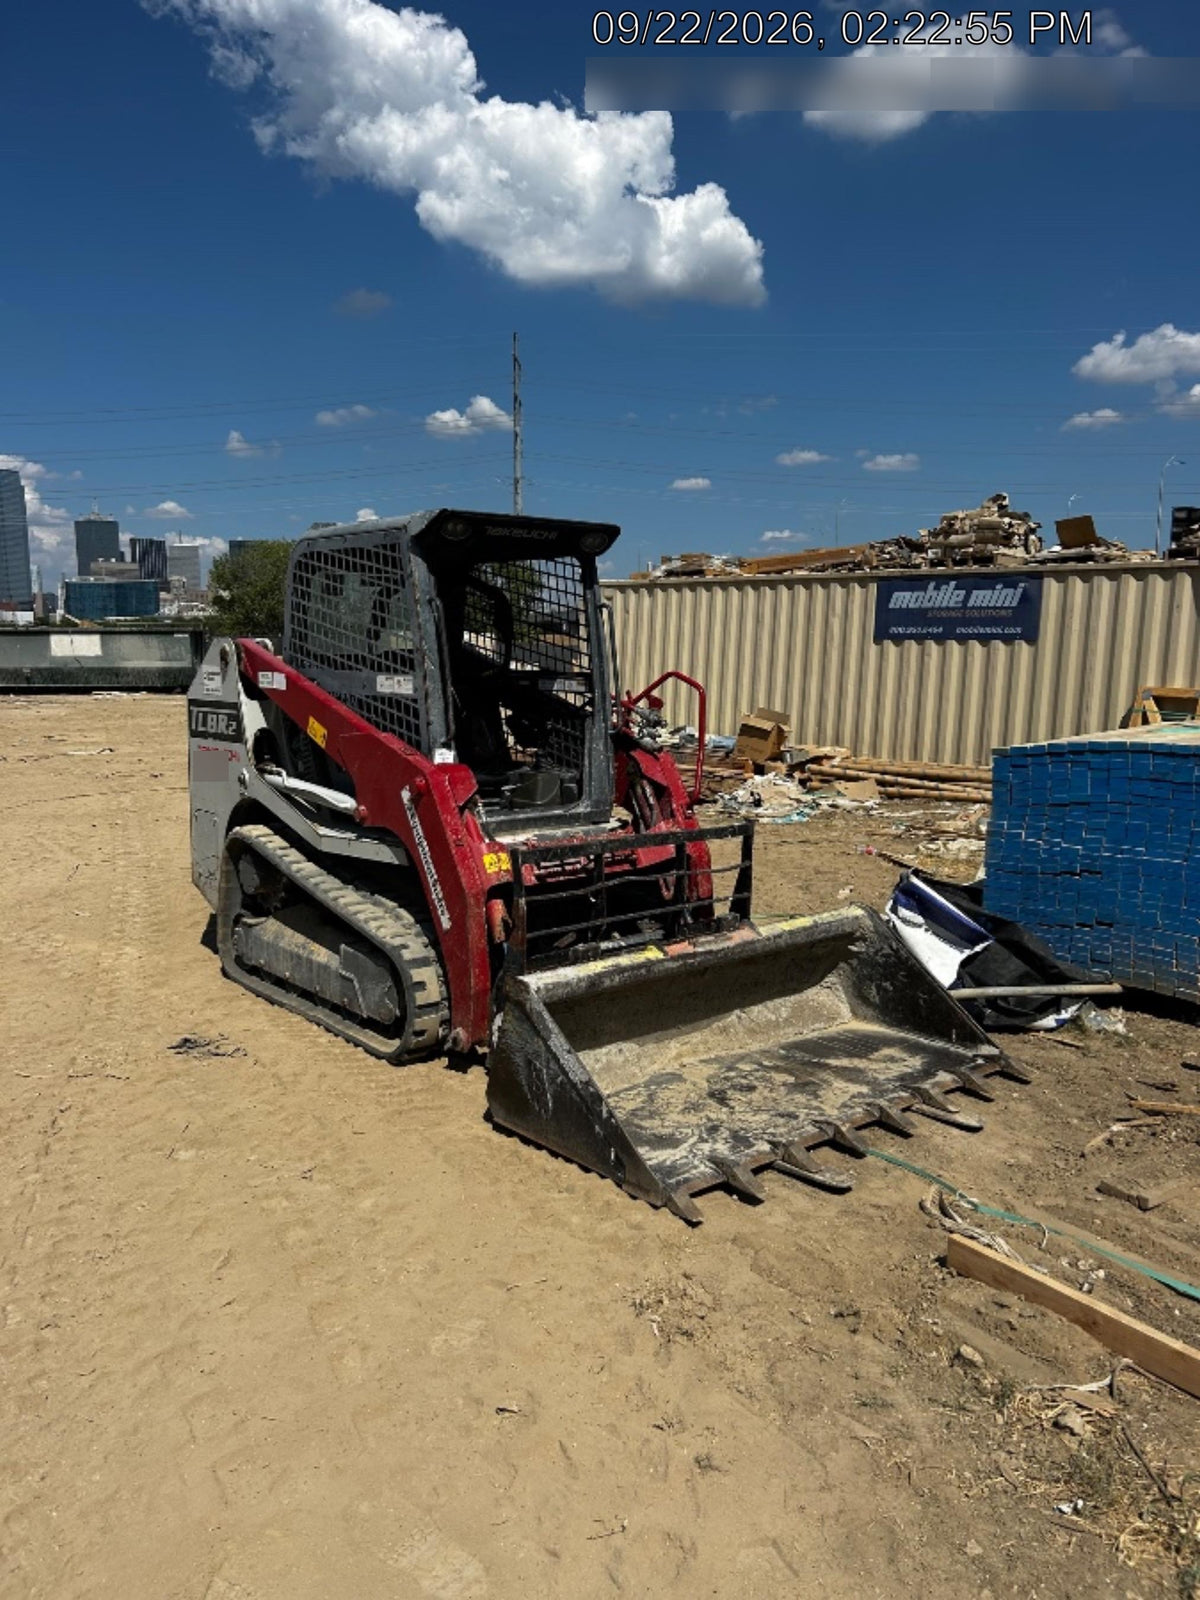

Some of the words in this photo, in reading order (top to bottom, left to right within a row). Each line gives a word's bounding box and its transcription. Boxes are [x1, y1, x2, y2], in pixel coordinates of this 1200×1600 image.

[888, 581, 966, 608] mobile
[967, 583, 1025, 608] mini
[965, 609, 1013, 617] SOLUTIONS
